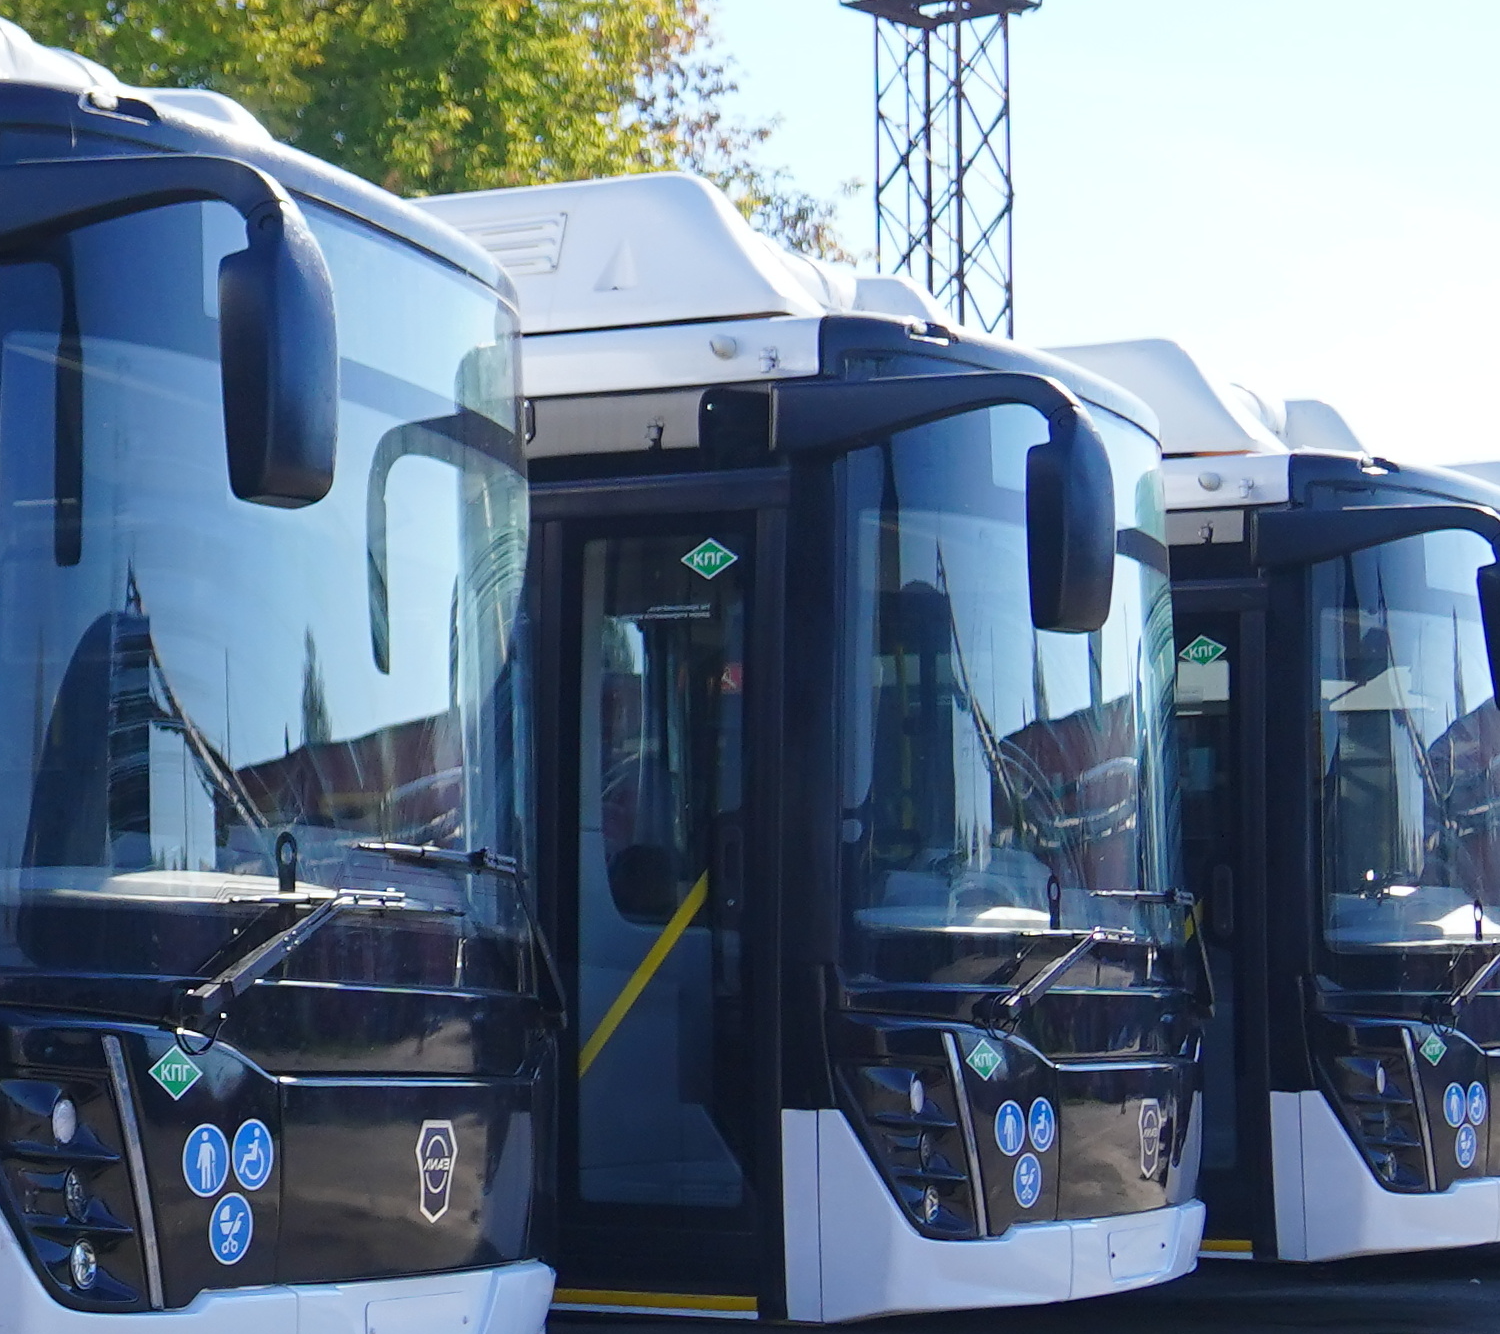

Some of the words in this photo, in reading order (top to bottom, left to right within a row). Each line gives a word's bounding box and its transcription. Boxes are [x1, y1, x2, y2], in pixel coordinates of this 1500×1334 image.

[692, 551, 724, 567] КПГ
[1190, 644, 1215, 659] КПГ
[161, 1063, 191, 1082] КПГ
